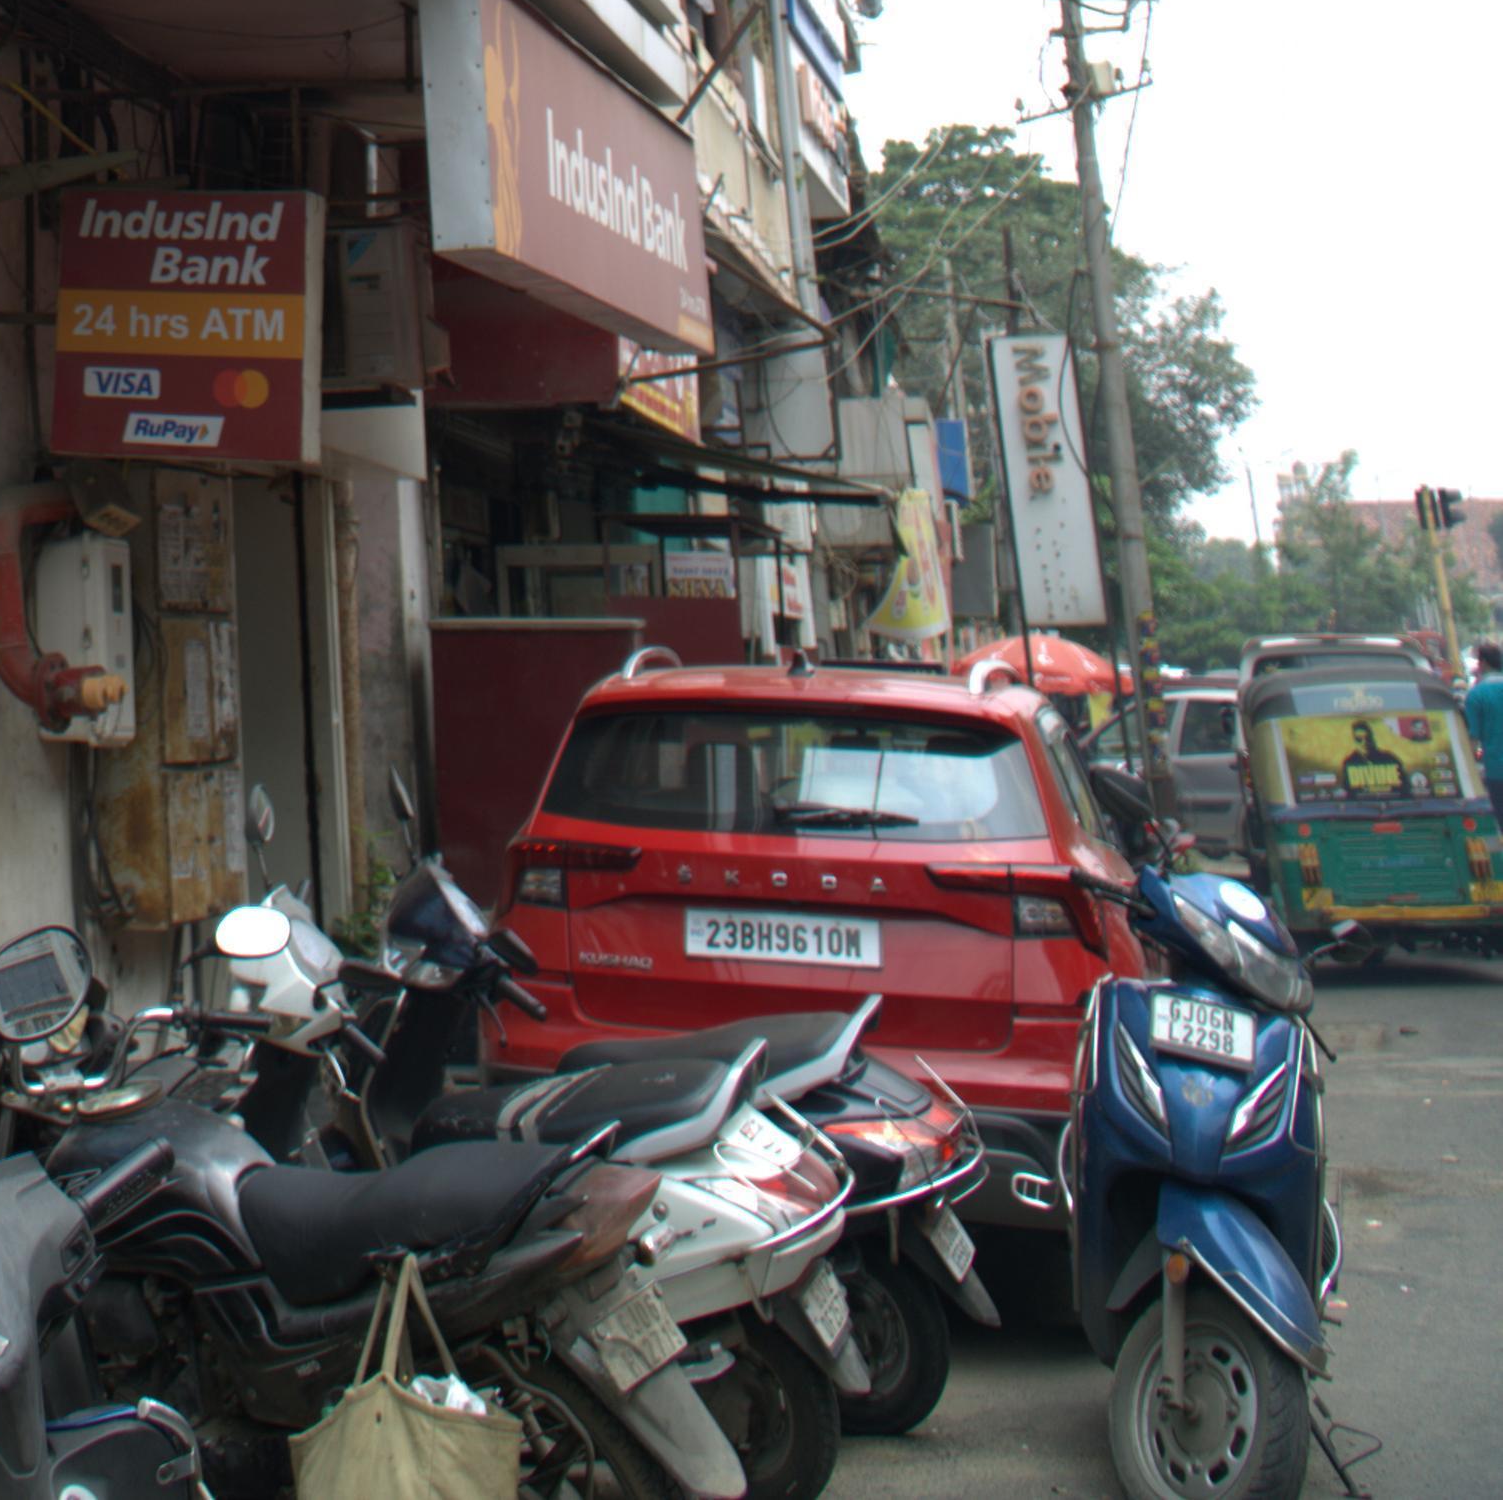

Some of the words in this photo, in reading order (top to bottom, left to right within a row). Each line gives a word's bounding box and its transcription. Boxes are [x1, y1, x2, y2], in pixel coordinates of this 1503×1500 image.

[545, 106, 641, 245] IndusInd
[640, 176, 689, 274] Bank
[78, 198, 284, 241] IndusInd
[150, 246, 270, 285] Bank
[72, 304, 117, 337] 24
[128, 306, 190, 340] hrs
[200, 308, 285, 341] ATM
[92, 370, 154, 396] VISA
[134, 419, 199, 443] RuPay
[706, 919, 862, 958] 23BH9610M
[1169, 998, 1234, 1032] GJ06N
[1168, 1020, 1234, 1054] L2298
